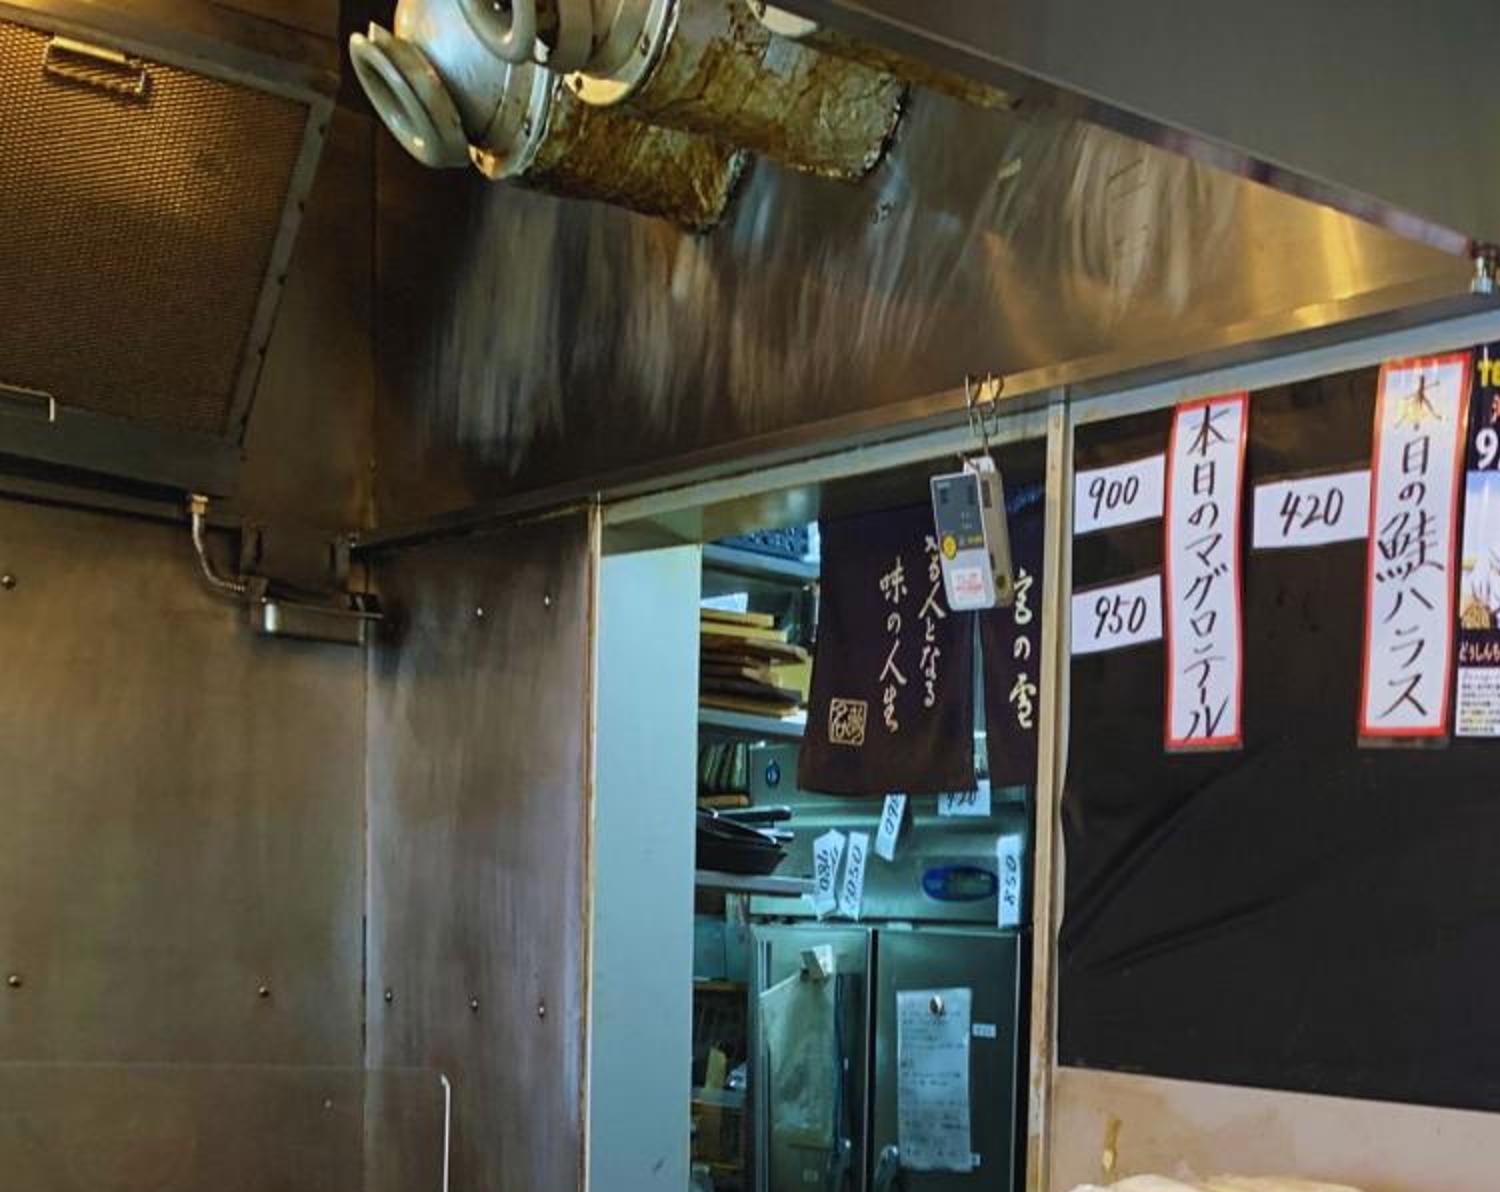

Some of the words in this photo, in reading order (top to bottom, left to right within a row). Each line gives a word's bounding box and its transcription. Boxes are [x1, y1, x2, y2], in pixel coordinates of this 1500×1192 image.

[1088, 475, 1139, 519] 900
[1279, 487, 1344, 537] 420
[1375, 374, 1446, 720] 本日の鮭ハラス
[1184, 404, 1235, 743] 本日のマグロテール
[1094, 595, 1147, 640] 950
